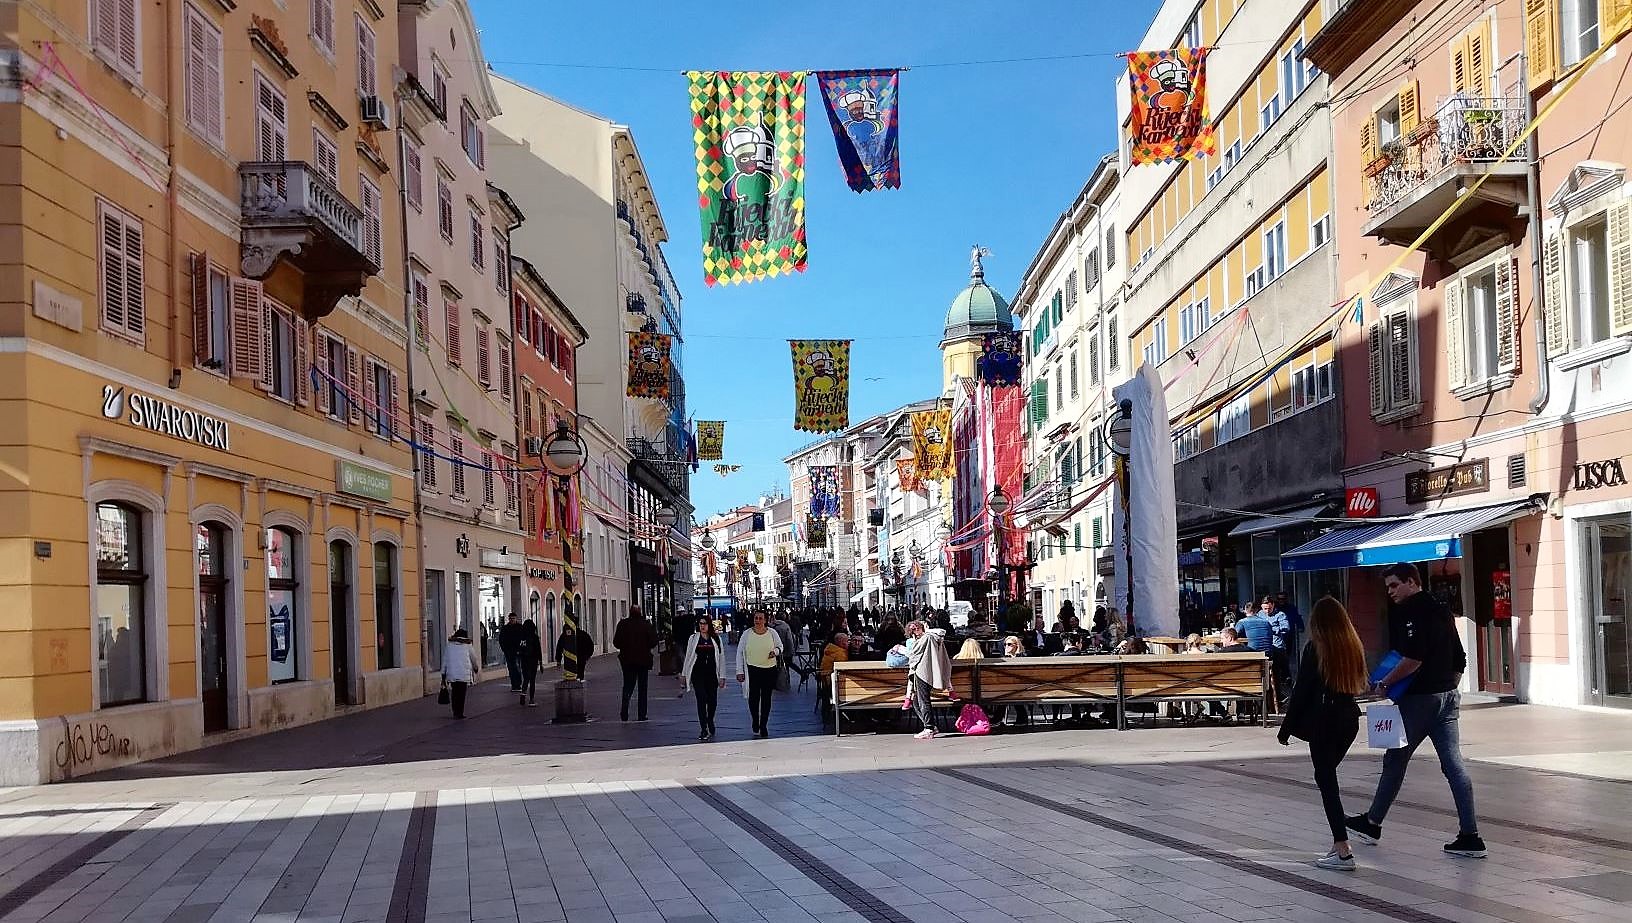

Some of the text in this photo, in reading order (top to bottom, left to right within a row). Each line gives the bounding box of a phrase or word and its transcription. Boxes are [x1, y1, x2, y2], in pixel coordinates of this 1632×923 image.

[129, 393, 230, 451] SWAROVSKI
[1456, 469, 1473, 487] Pub
[1573, 459, 1628, 491] LISCA
[1349, 491, 1376, 515] illy
